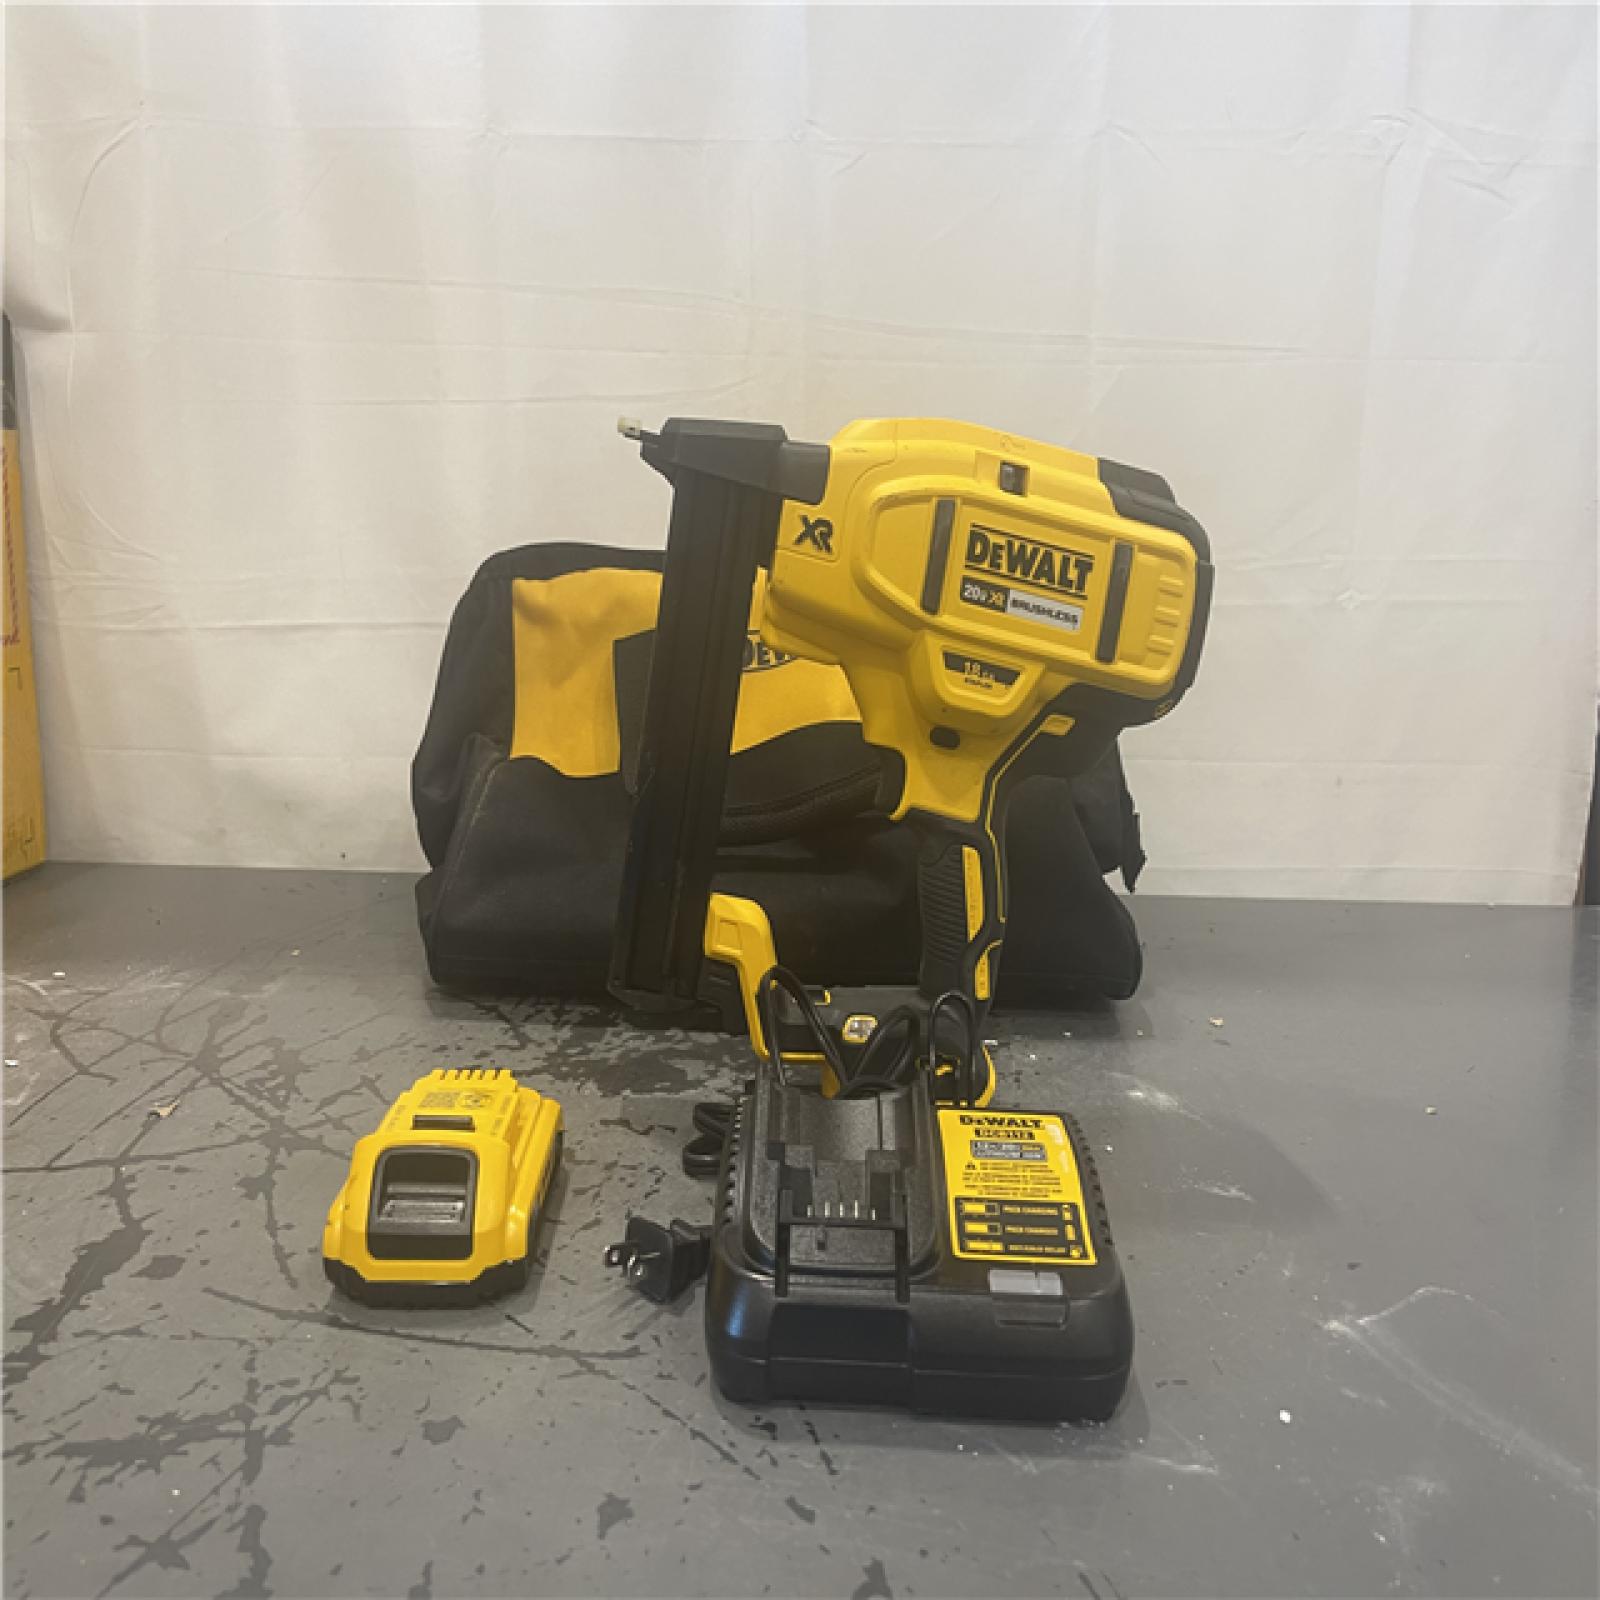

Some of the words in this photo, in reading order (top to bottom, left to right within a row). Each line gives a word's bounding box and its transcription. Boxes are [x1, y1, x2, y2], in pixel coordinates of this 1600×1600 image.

[794, 515, 834, 553] XR
[965, 529, 1094, 593] DEWALT
[1010, 597, 1079, 624] BRUSHLESS
[960, 1115, 1043, 1129] DEWALT
